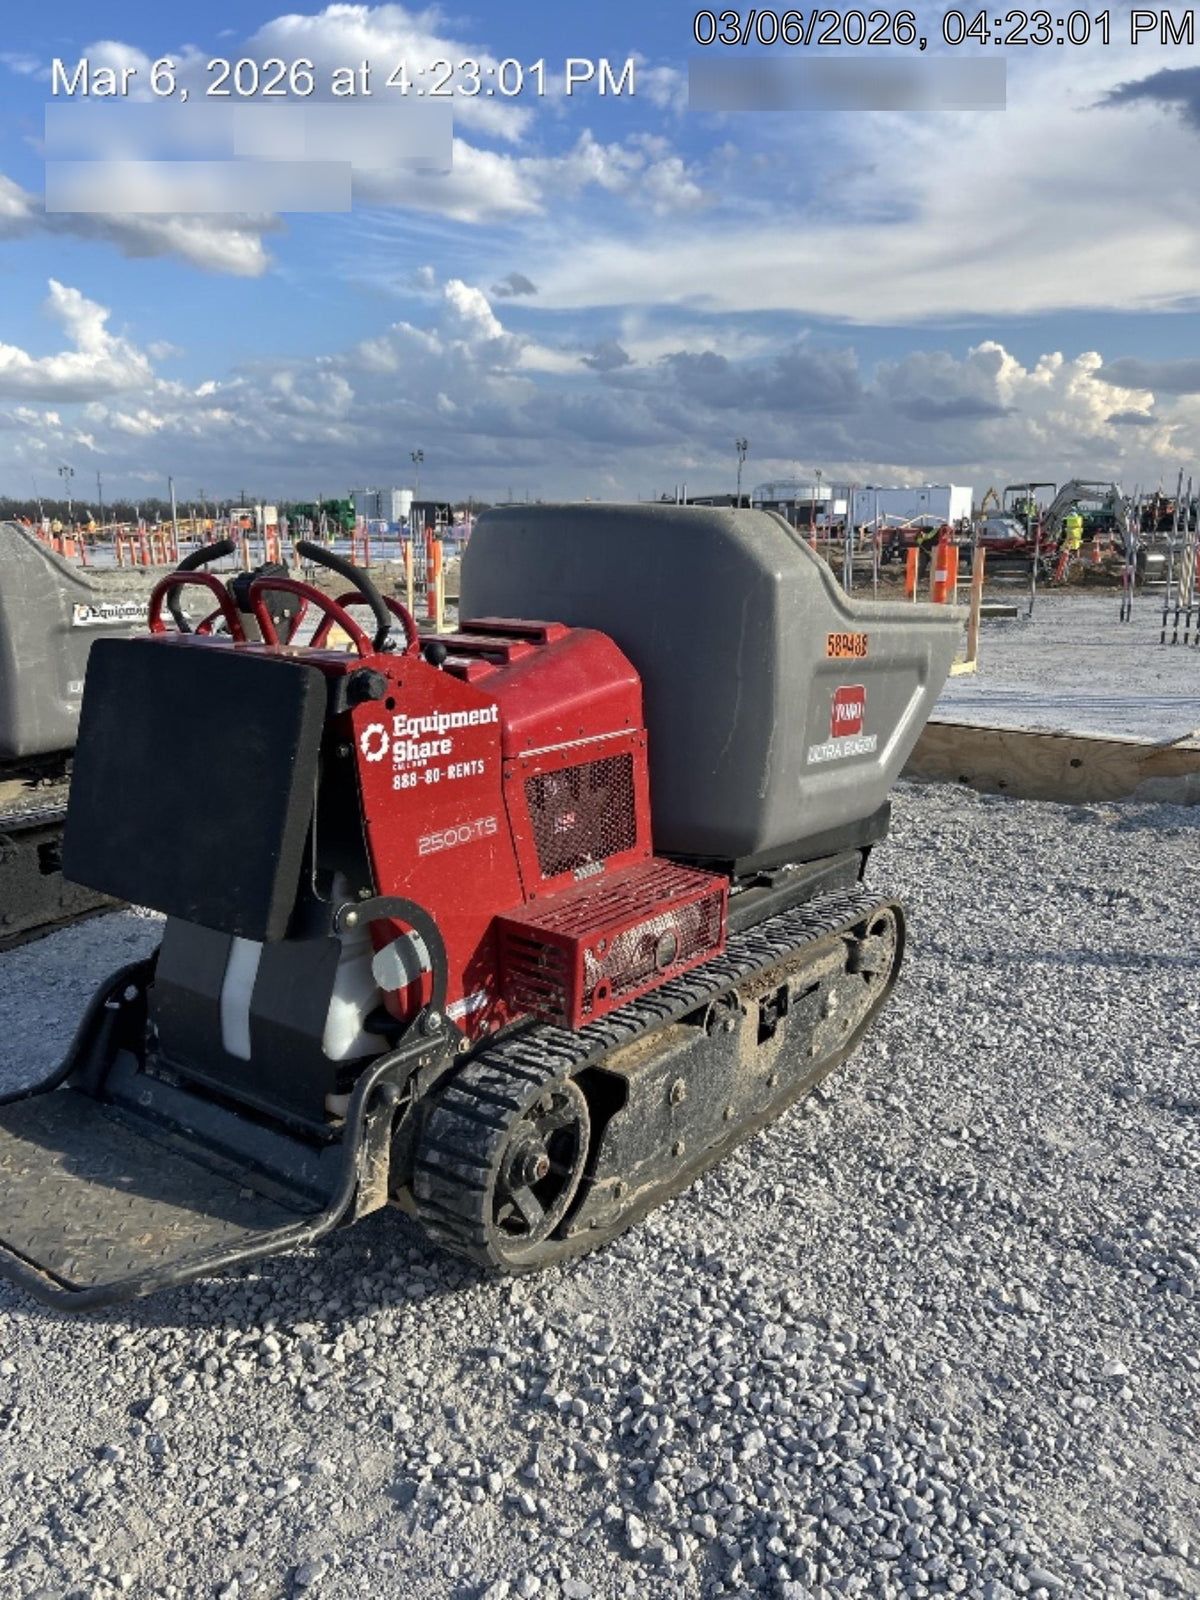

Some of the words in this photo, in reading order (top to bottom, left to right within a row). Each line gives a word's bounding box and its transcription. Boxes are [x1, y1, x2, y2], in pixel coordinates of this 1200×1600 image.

[393, 704, 498, 738] Equipment
[392, 738, 453, 762] Share
[392, 760, 485, 790] 888-80-RENTS
